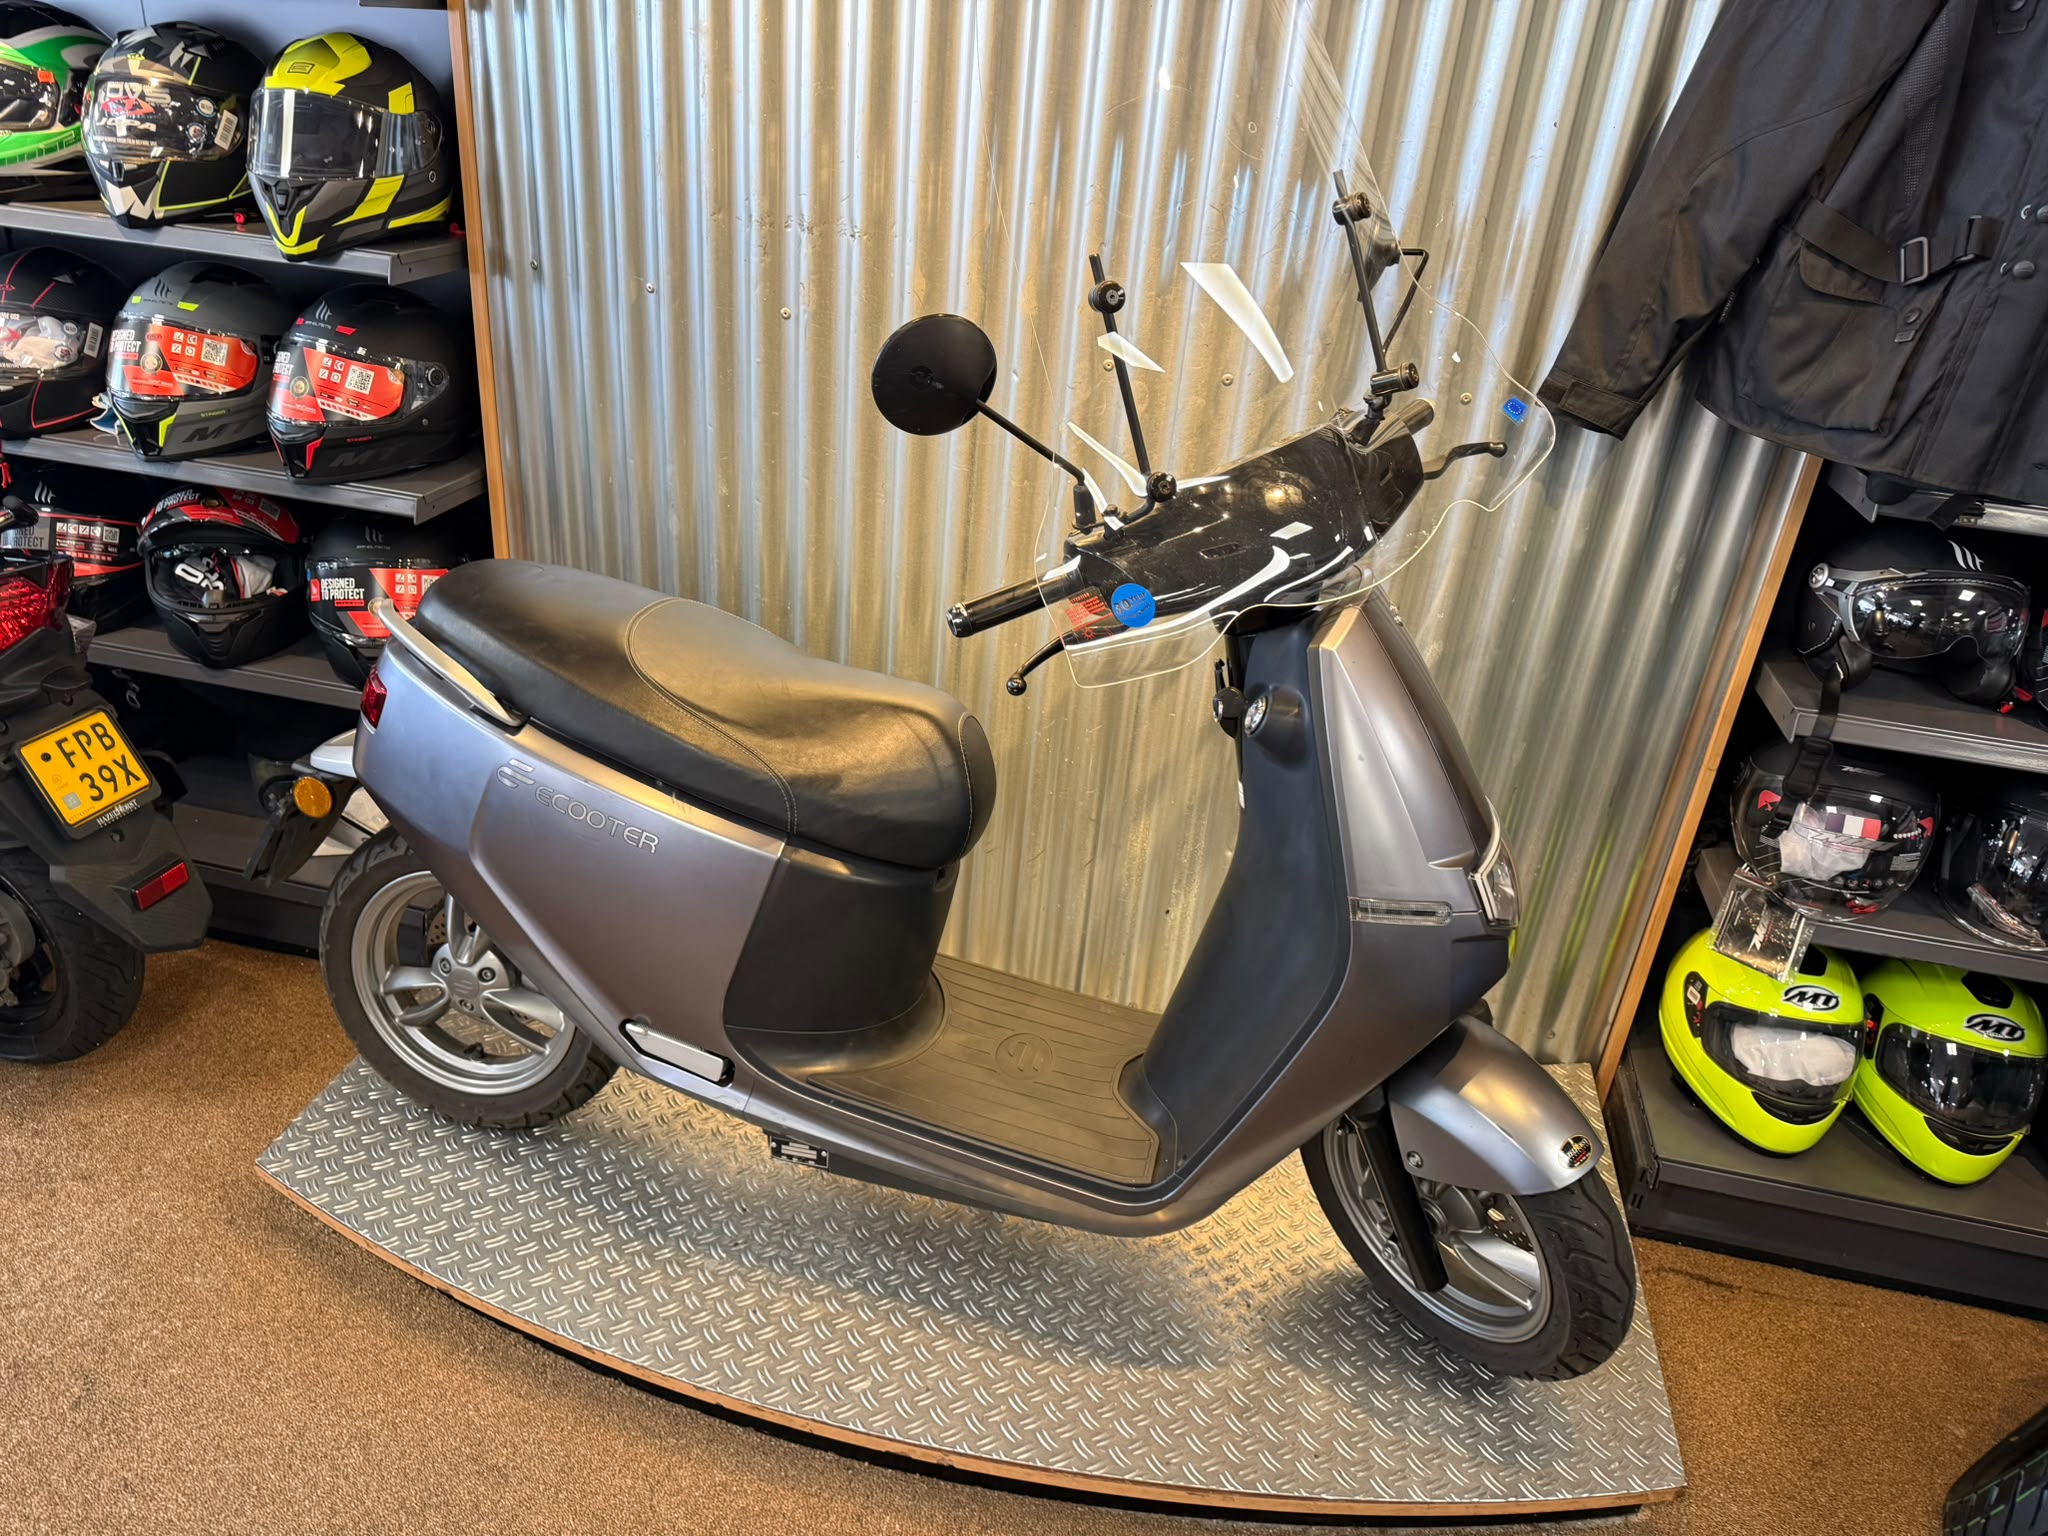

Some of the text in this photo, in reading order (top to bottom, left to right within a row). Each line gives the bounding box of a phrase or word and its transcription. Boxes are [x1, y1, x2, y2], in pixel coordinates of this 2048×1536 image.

[321, 578, 355, 589] DESIGNED
[321, 588, 365, 600] TO PROTECT
[55, 722, 115, 768] FPB
[79, 754, 141, 802] 39X
[535, 786, 660, 854] ECOOTER
[1784, 989, 1839, 1009] MT
[1966, 1017, 2024, 1038] MT
